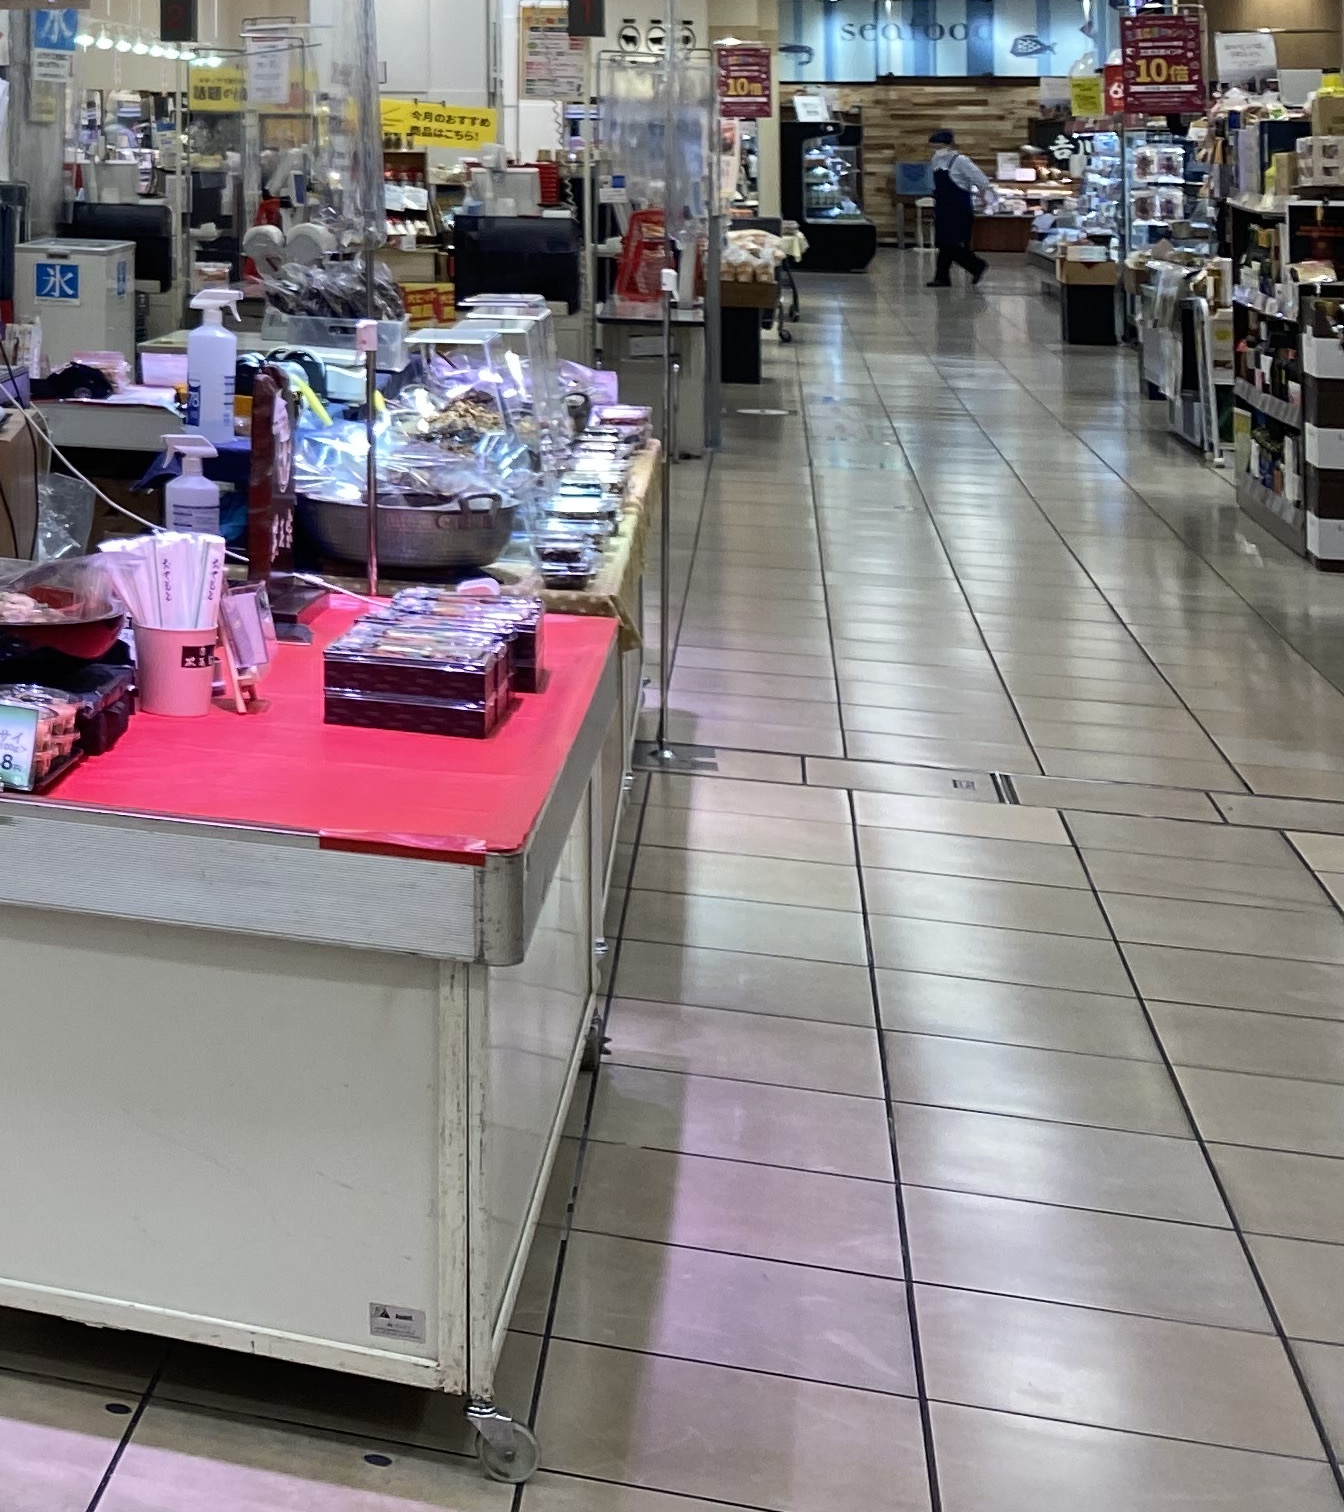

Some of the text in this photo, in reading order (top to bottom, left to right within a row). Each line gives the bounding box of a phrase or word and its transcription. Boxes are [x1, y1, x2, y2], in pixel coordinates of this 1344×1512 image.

[840, 17, 994, 42] seaood
[1135, 57, 1190, 83] 10倍
[411, 110, 492, 128] 今月のおすすめ
[42, 265, 77, 295] 氷
